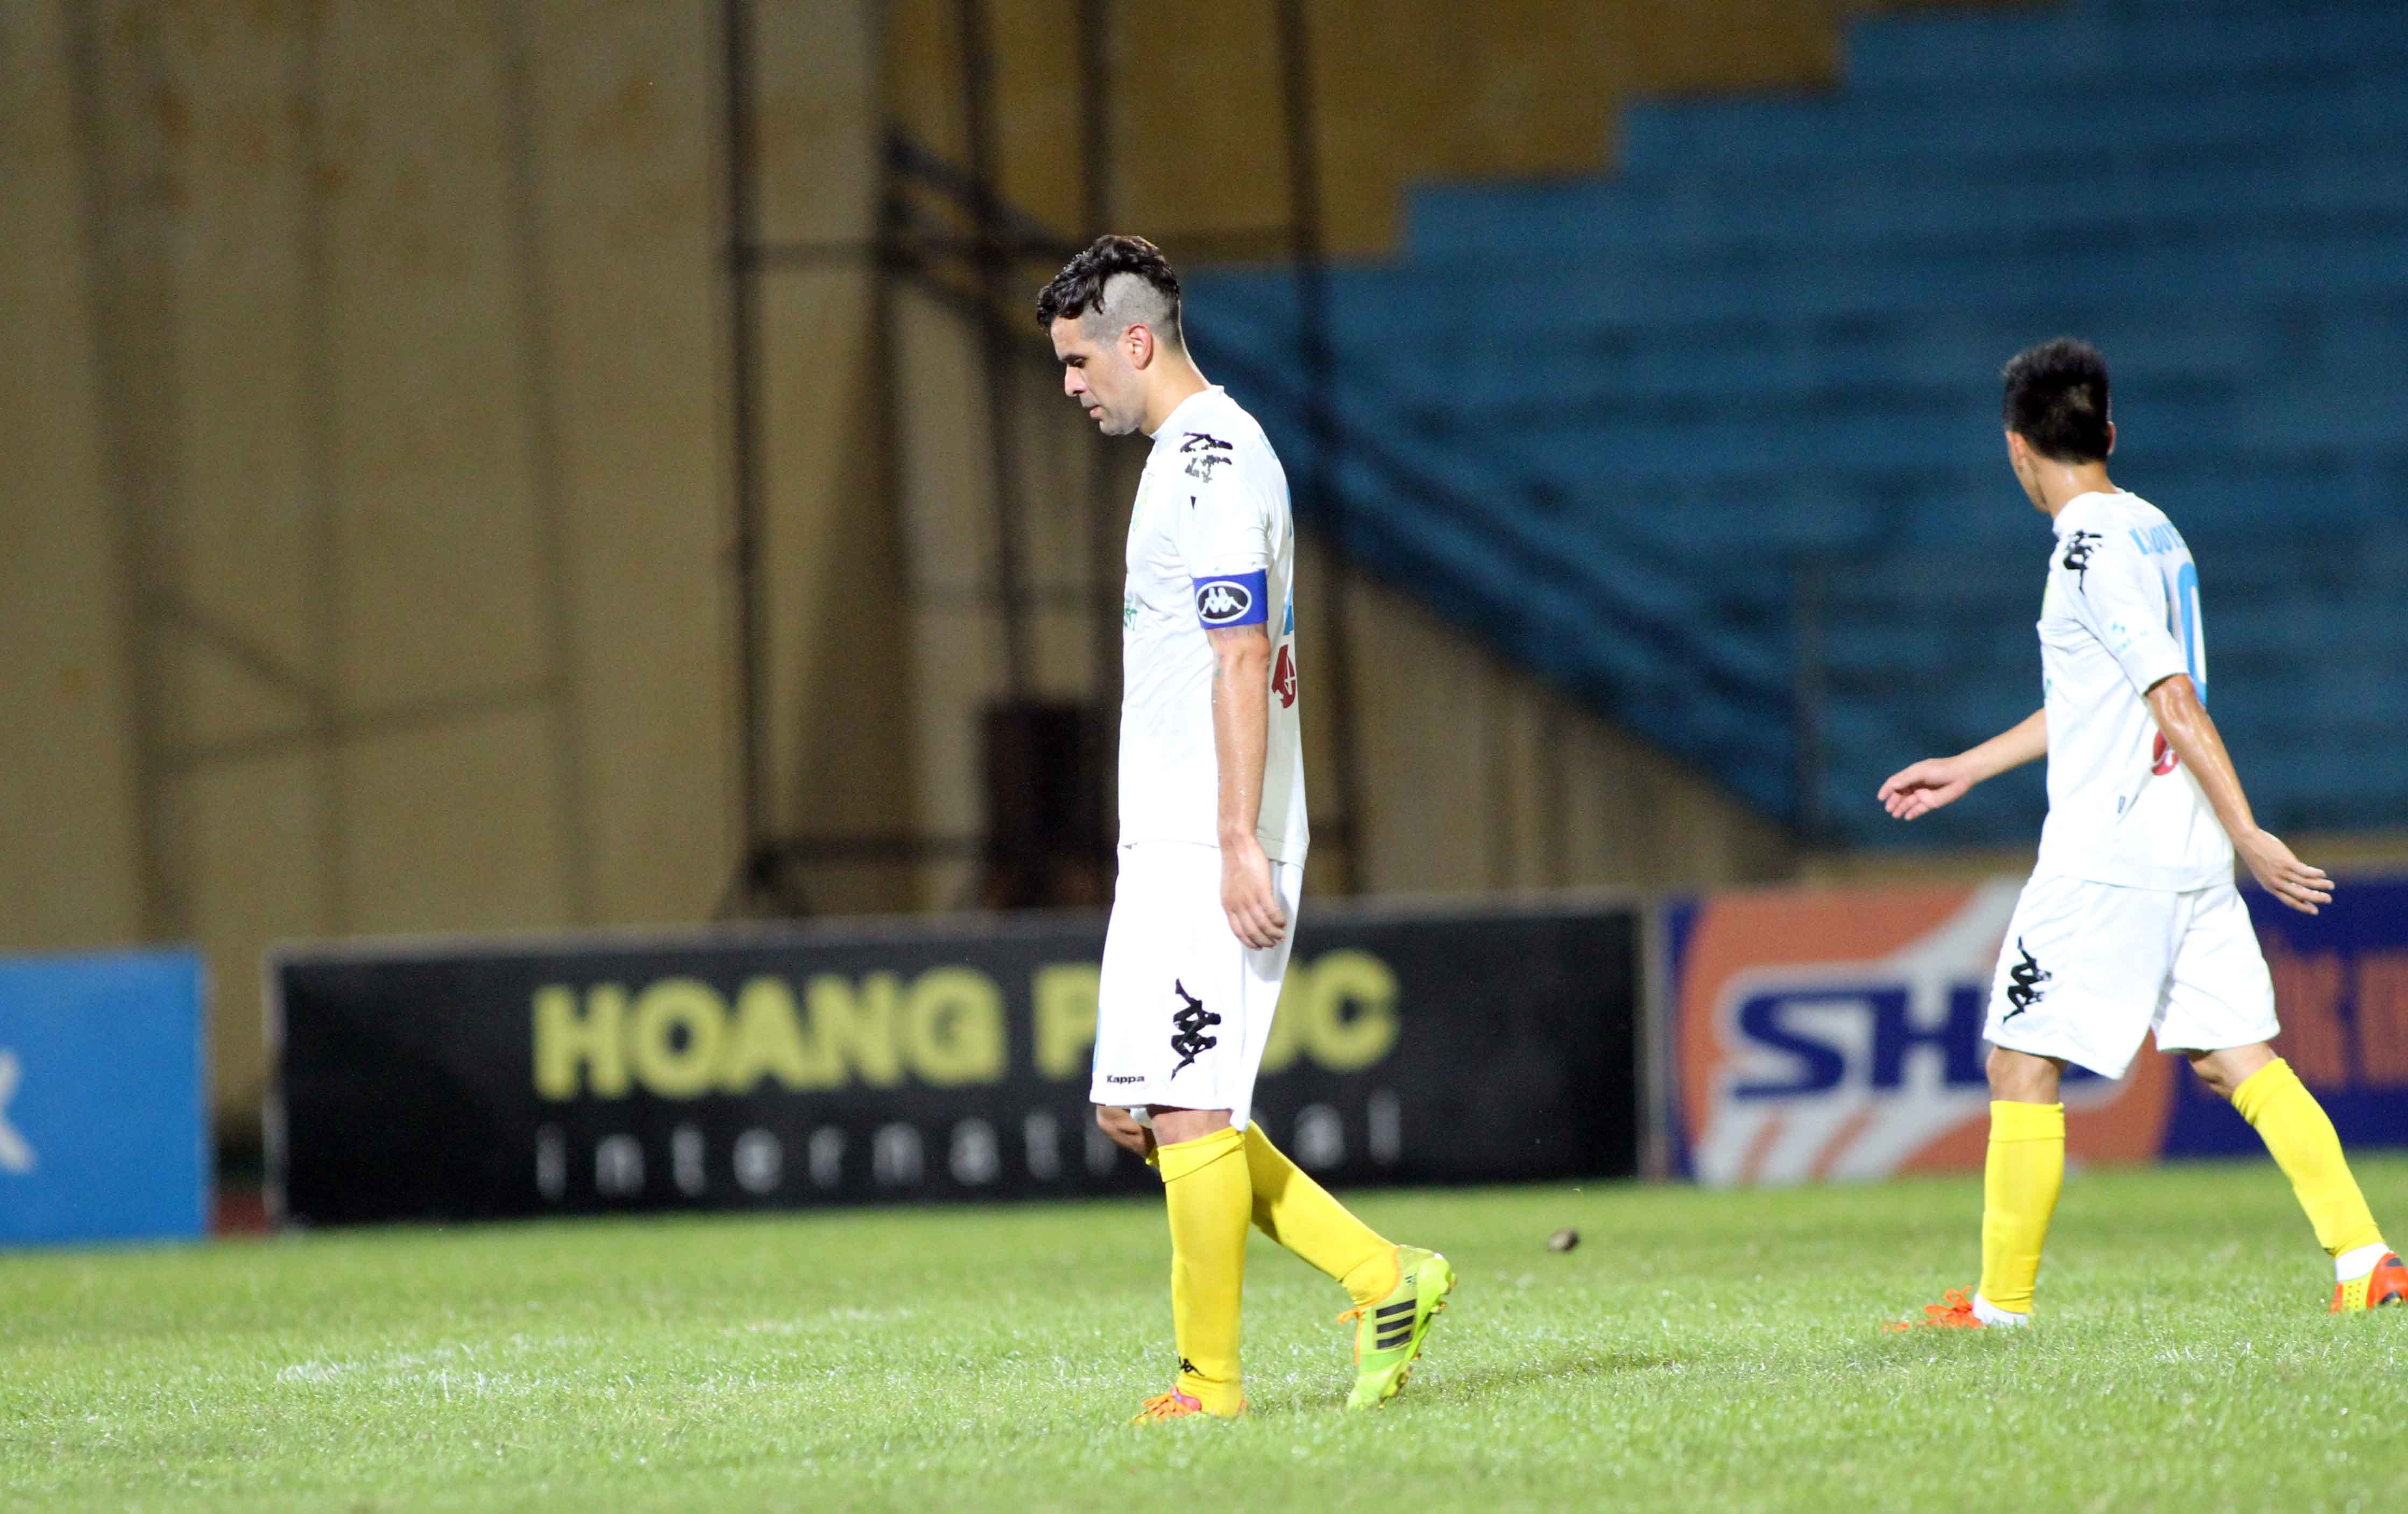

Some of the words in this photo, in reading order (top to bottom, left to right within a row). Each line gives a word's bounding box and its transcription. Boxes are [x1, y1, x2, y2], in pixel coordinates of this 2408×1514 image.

[534, 967, 1006, 1101] HOANG
[1107, 1075, 1145, 1085] Kappa
[1734, 982, 2115, 1100] SH
